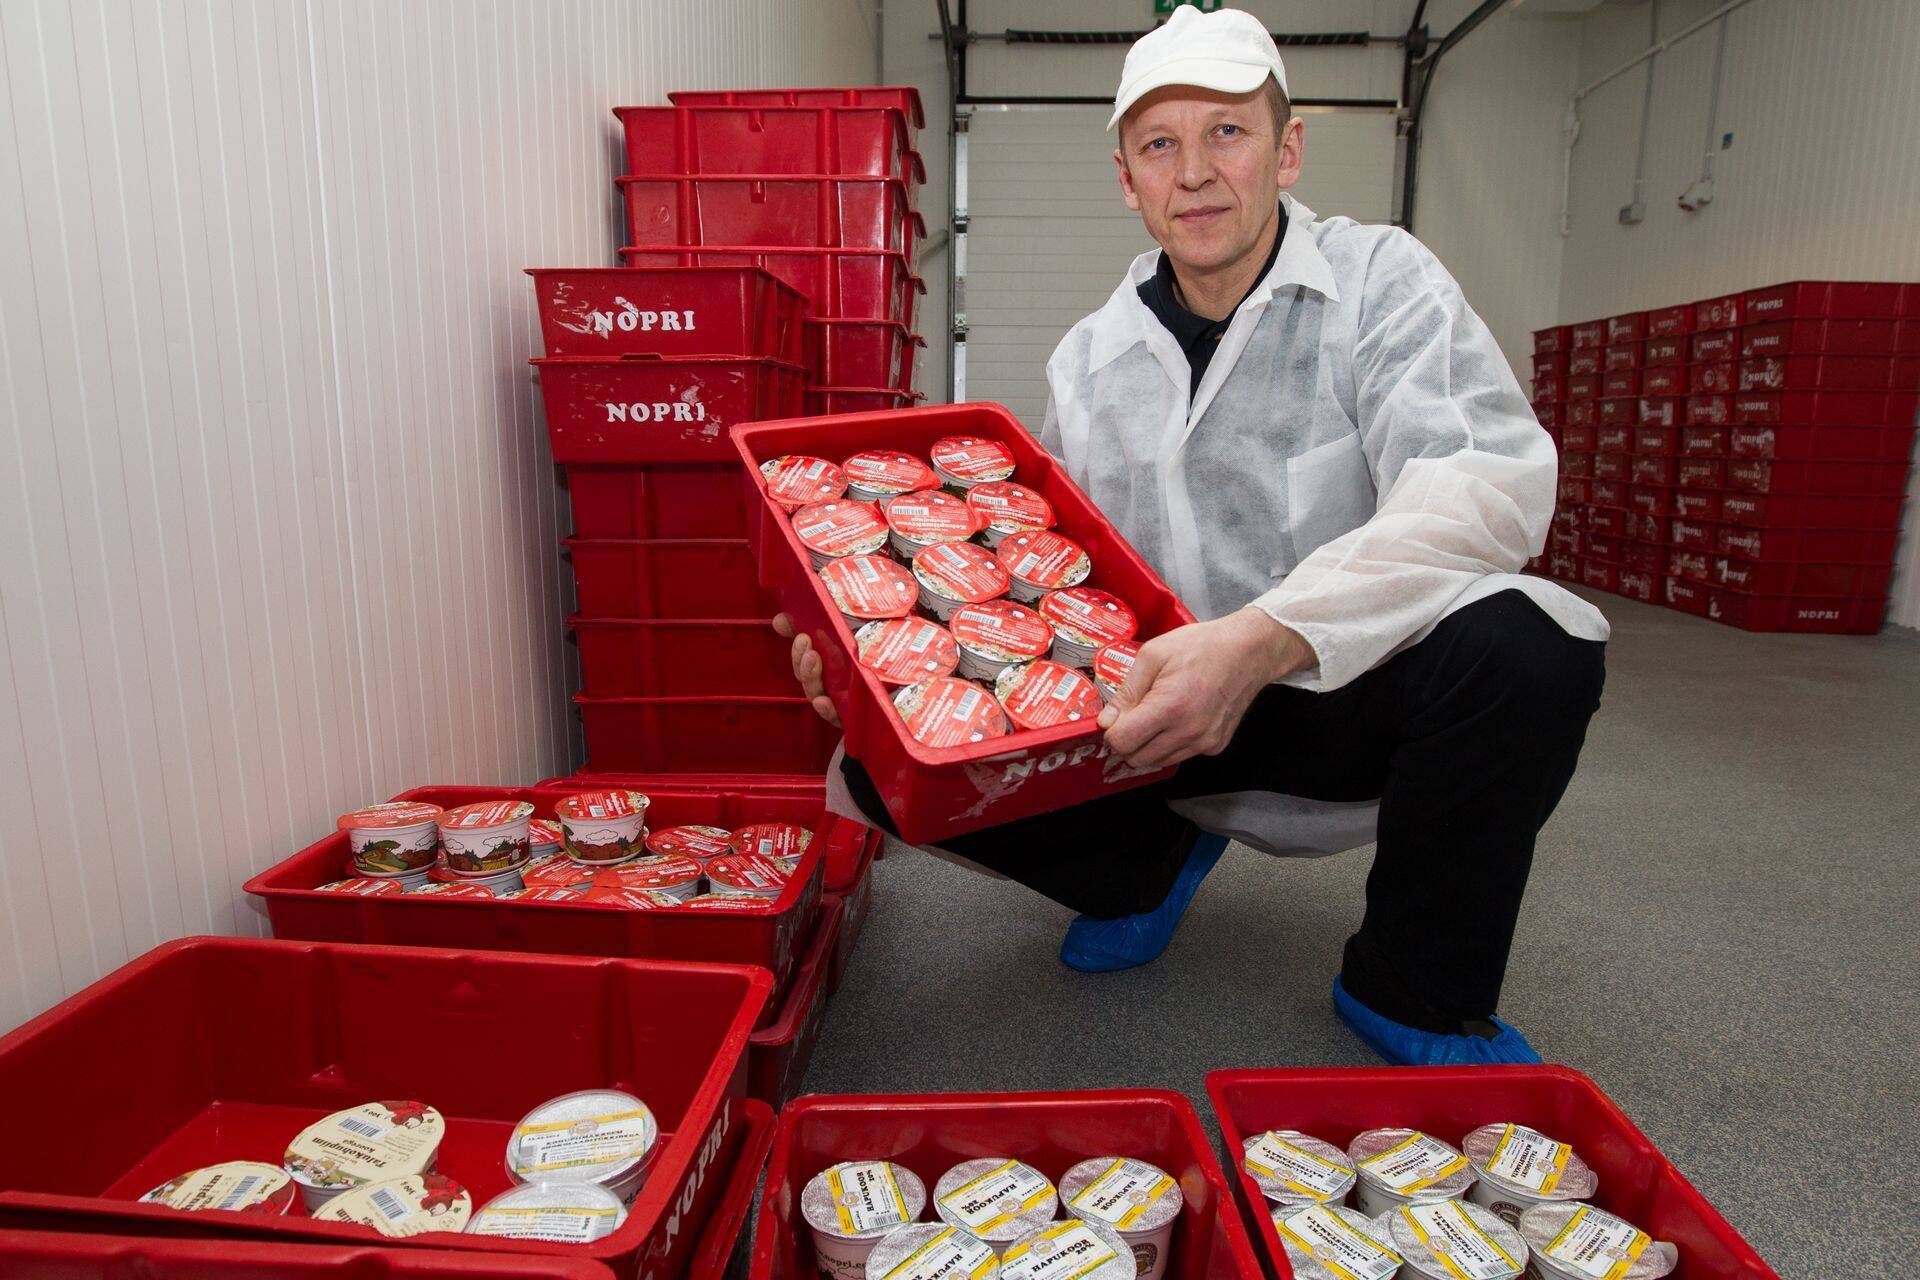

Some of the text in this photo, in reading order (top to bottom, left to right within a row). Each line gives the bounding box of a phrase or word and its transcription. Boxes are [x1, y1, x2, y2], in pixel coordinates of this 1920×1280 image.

[1757, 299, 1784, 311] NOPRI
[594, 311, 696, 331] NOPRI
[1753, 336, 1779, 346] NOPRI
[605, 403, 705, 423] NOPRI
[1744, 402, 1769, 410] NOPRI
[1798, 610, 1839, 619] NOPRI
[311, 1134, 386, 1169] Talukohupiim
[1261, 1146, 1324, 1179] MAITSESTAMATA
[1263, 1152, 1312, 1178] TALUJOGURT
[1380, 1151, 1428, 1176] MAITSESTAMATA
[1510, 1143, 1532, 1178] MAITSESTAMATA
[1520, 1149, 1537, 1177] TALUJOGURT
[664, 1097, 730, 1256] NOPRI
[866, 1169, 874, 1181] 20%
[1391, 1156, 1429, 1177] TALUJOGURT
[856, 1172, 874, 1211] HAPUKOOR
[960, 1199, 977, 1211] 20%
[965, 1182, 1017, 1215] HAPUKOOR
[1091, 1195, 1105, 1208] 20%
[1099, 1179, 1136, 1212] HAPUKOOR
[1075, 1242, 1095, 1255] 20%
[1305, 1215, 1368, 1262] MAITSESTAMATA
[1306, 1223, 1356, 1260] TALUJOGURT
[1431, 1215, 1471, 1258] TALUJOGURT
[1433, 1210, 1484, 1263] MAITSESTAMATA
[1573, 1227, 1605, 1262] MAITSESTAMATA
[1584, 1234, 1610, 1262] TALUJOGURT
[1031, 1237, 1089, 1273] HAPUKOOR
